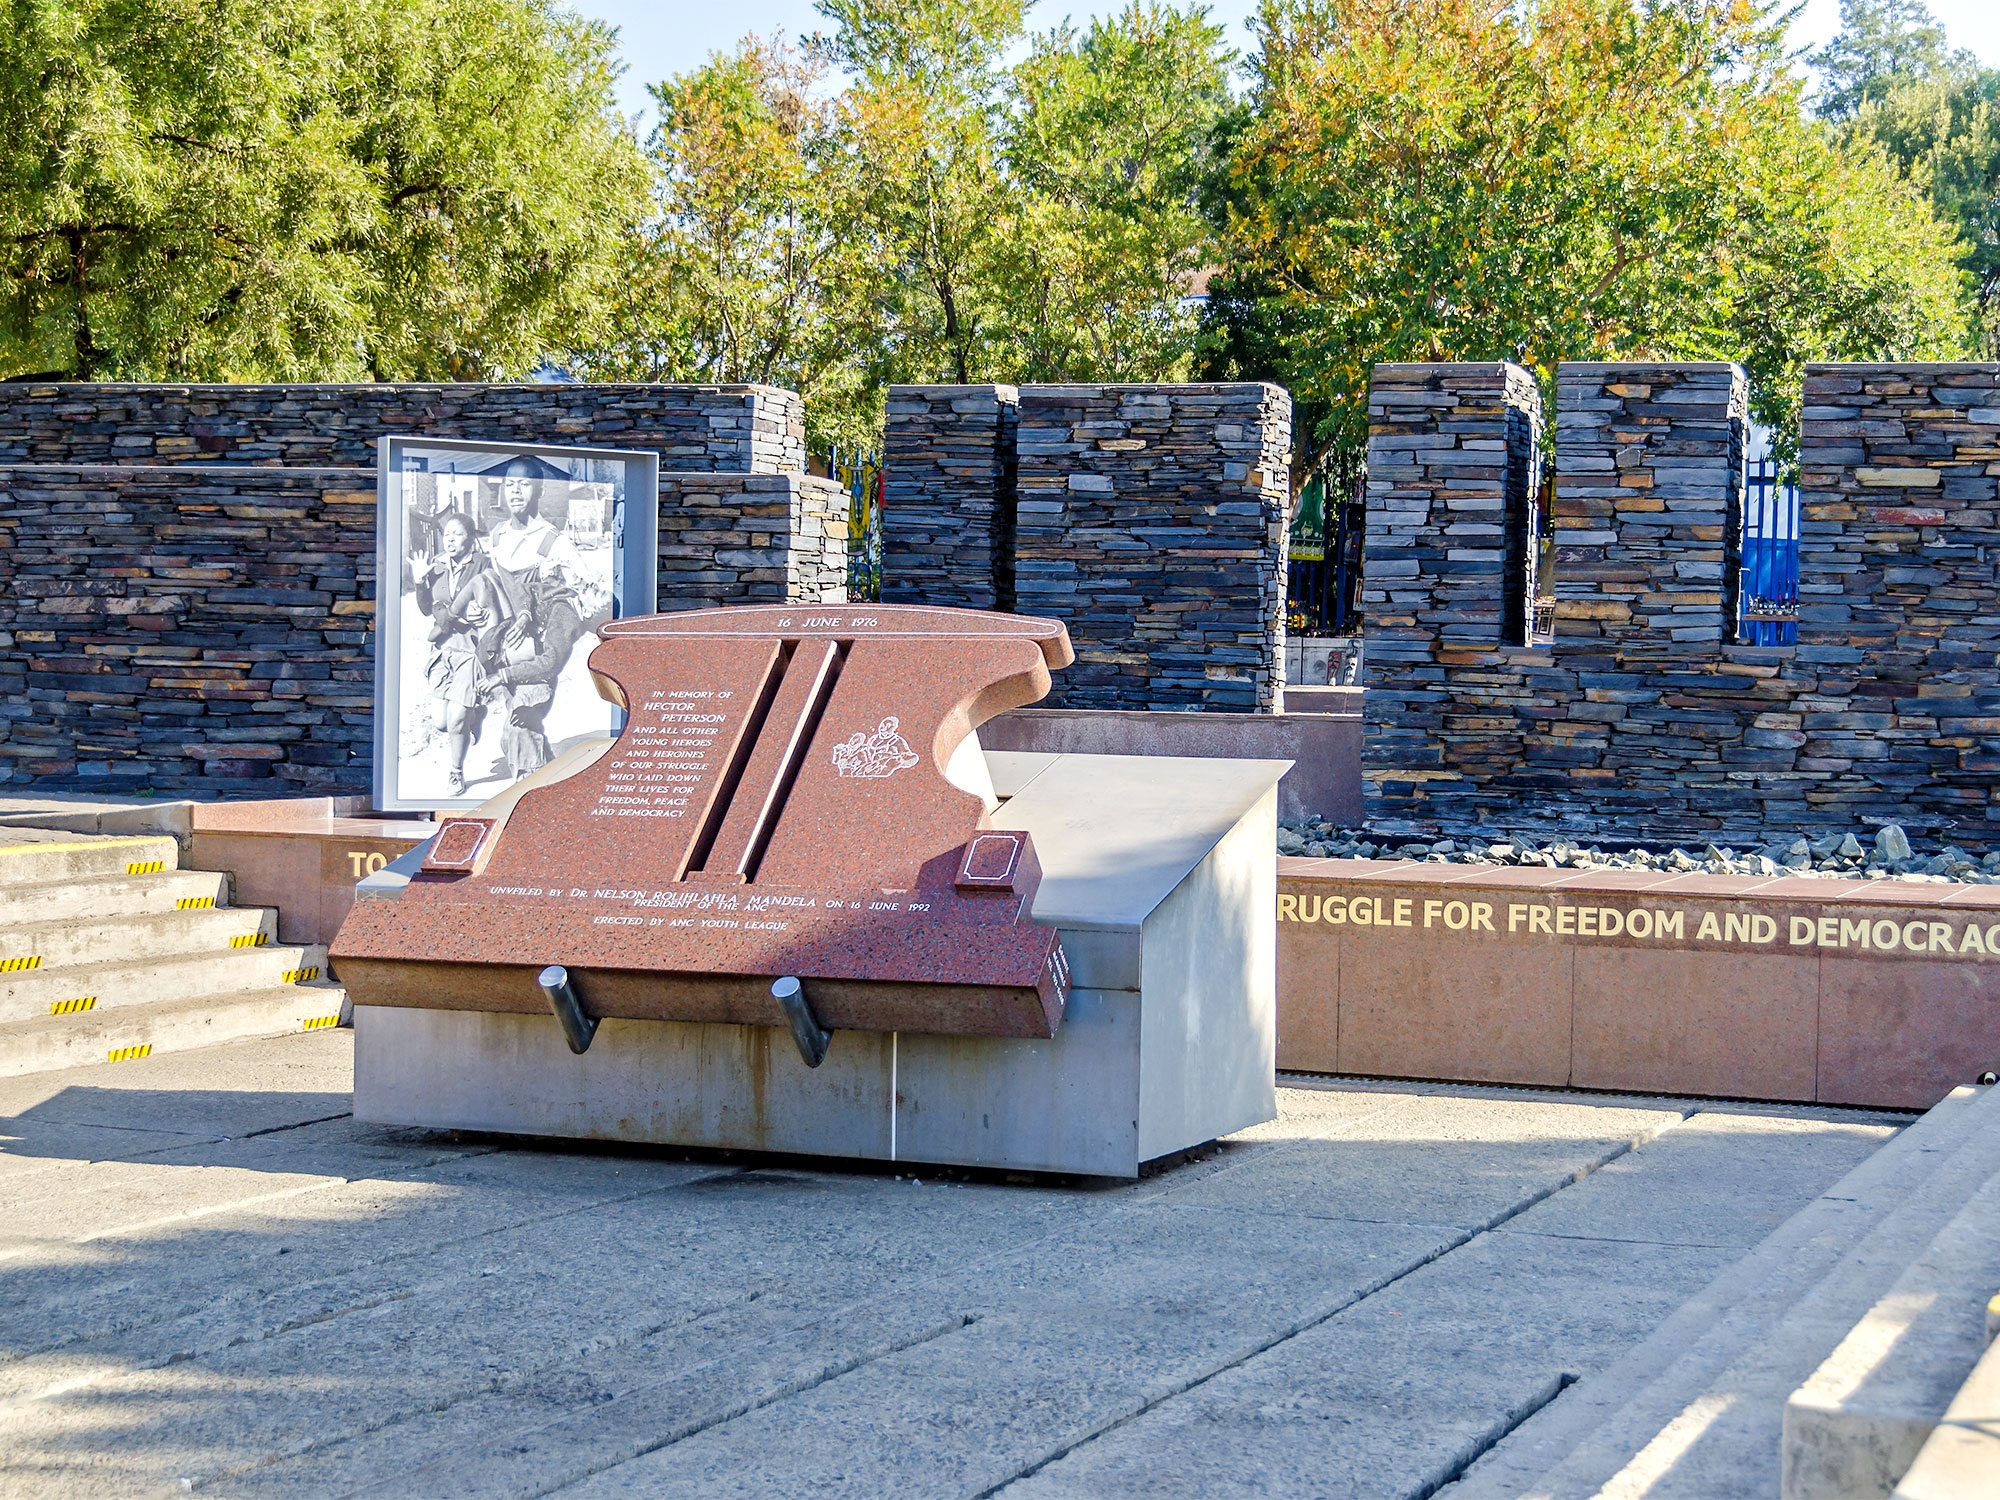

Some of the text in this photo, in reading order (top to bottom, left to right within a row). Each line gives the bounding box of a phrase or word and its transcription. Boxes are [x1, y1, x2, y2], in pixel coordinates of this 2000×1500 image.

[778, 617, 879, 628] 16 JUNE 1976
[669, 691, 714, 699] MEMORY
[643, 703, 695, 711] HECTOR
[661, 714, 726, 723] PETERSON
[656, 762, 709, 770] STRUGGLE
[667, 774, 701, 782] DOWN
[640, 785, 669, 793] LIVES
[673, 786, 695, 794] FOR
[618, 809, 686, 817] DEMOCRACY
[348, 851, 387, 877] TO
[490, 887, 543, 896] UNVEILED
[549, 888, 564, 897] BY
[594, 889, 648, 900] NELSON
[653, 891, 737, 903] ROLIHLAHLA
[749, 895, 816, 907] MANDELA
[825, 900, 844, 908] ON
[869, 902, 899, 911] JUNE
[634, 899, 769, 912] PRESIDENT OF THE ANC
[594, 916, 789, 930] ERECTED BY ANC YOUTH LEAGUE
[1423, 900, 1495, 931] FOR
[1508, 904, 1684, 939] FREEDOM
[1696, 911, 1778, 944] AND
